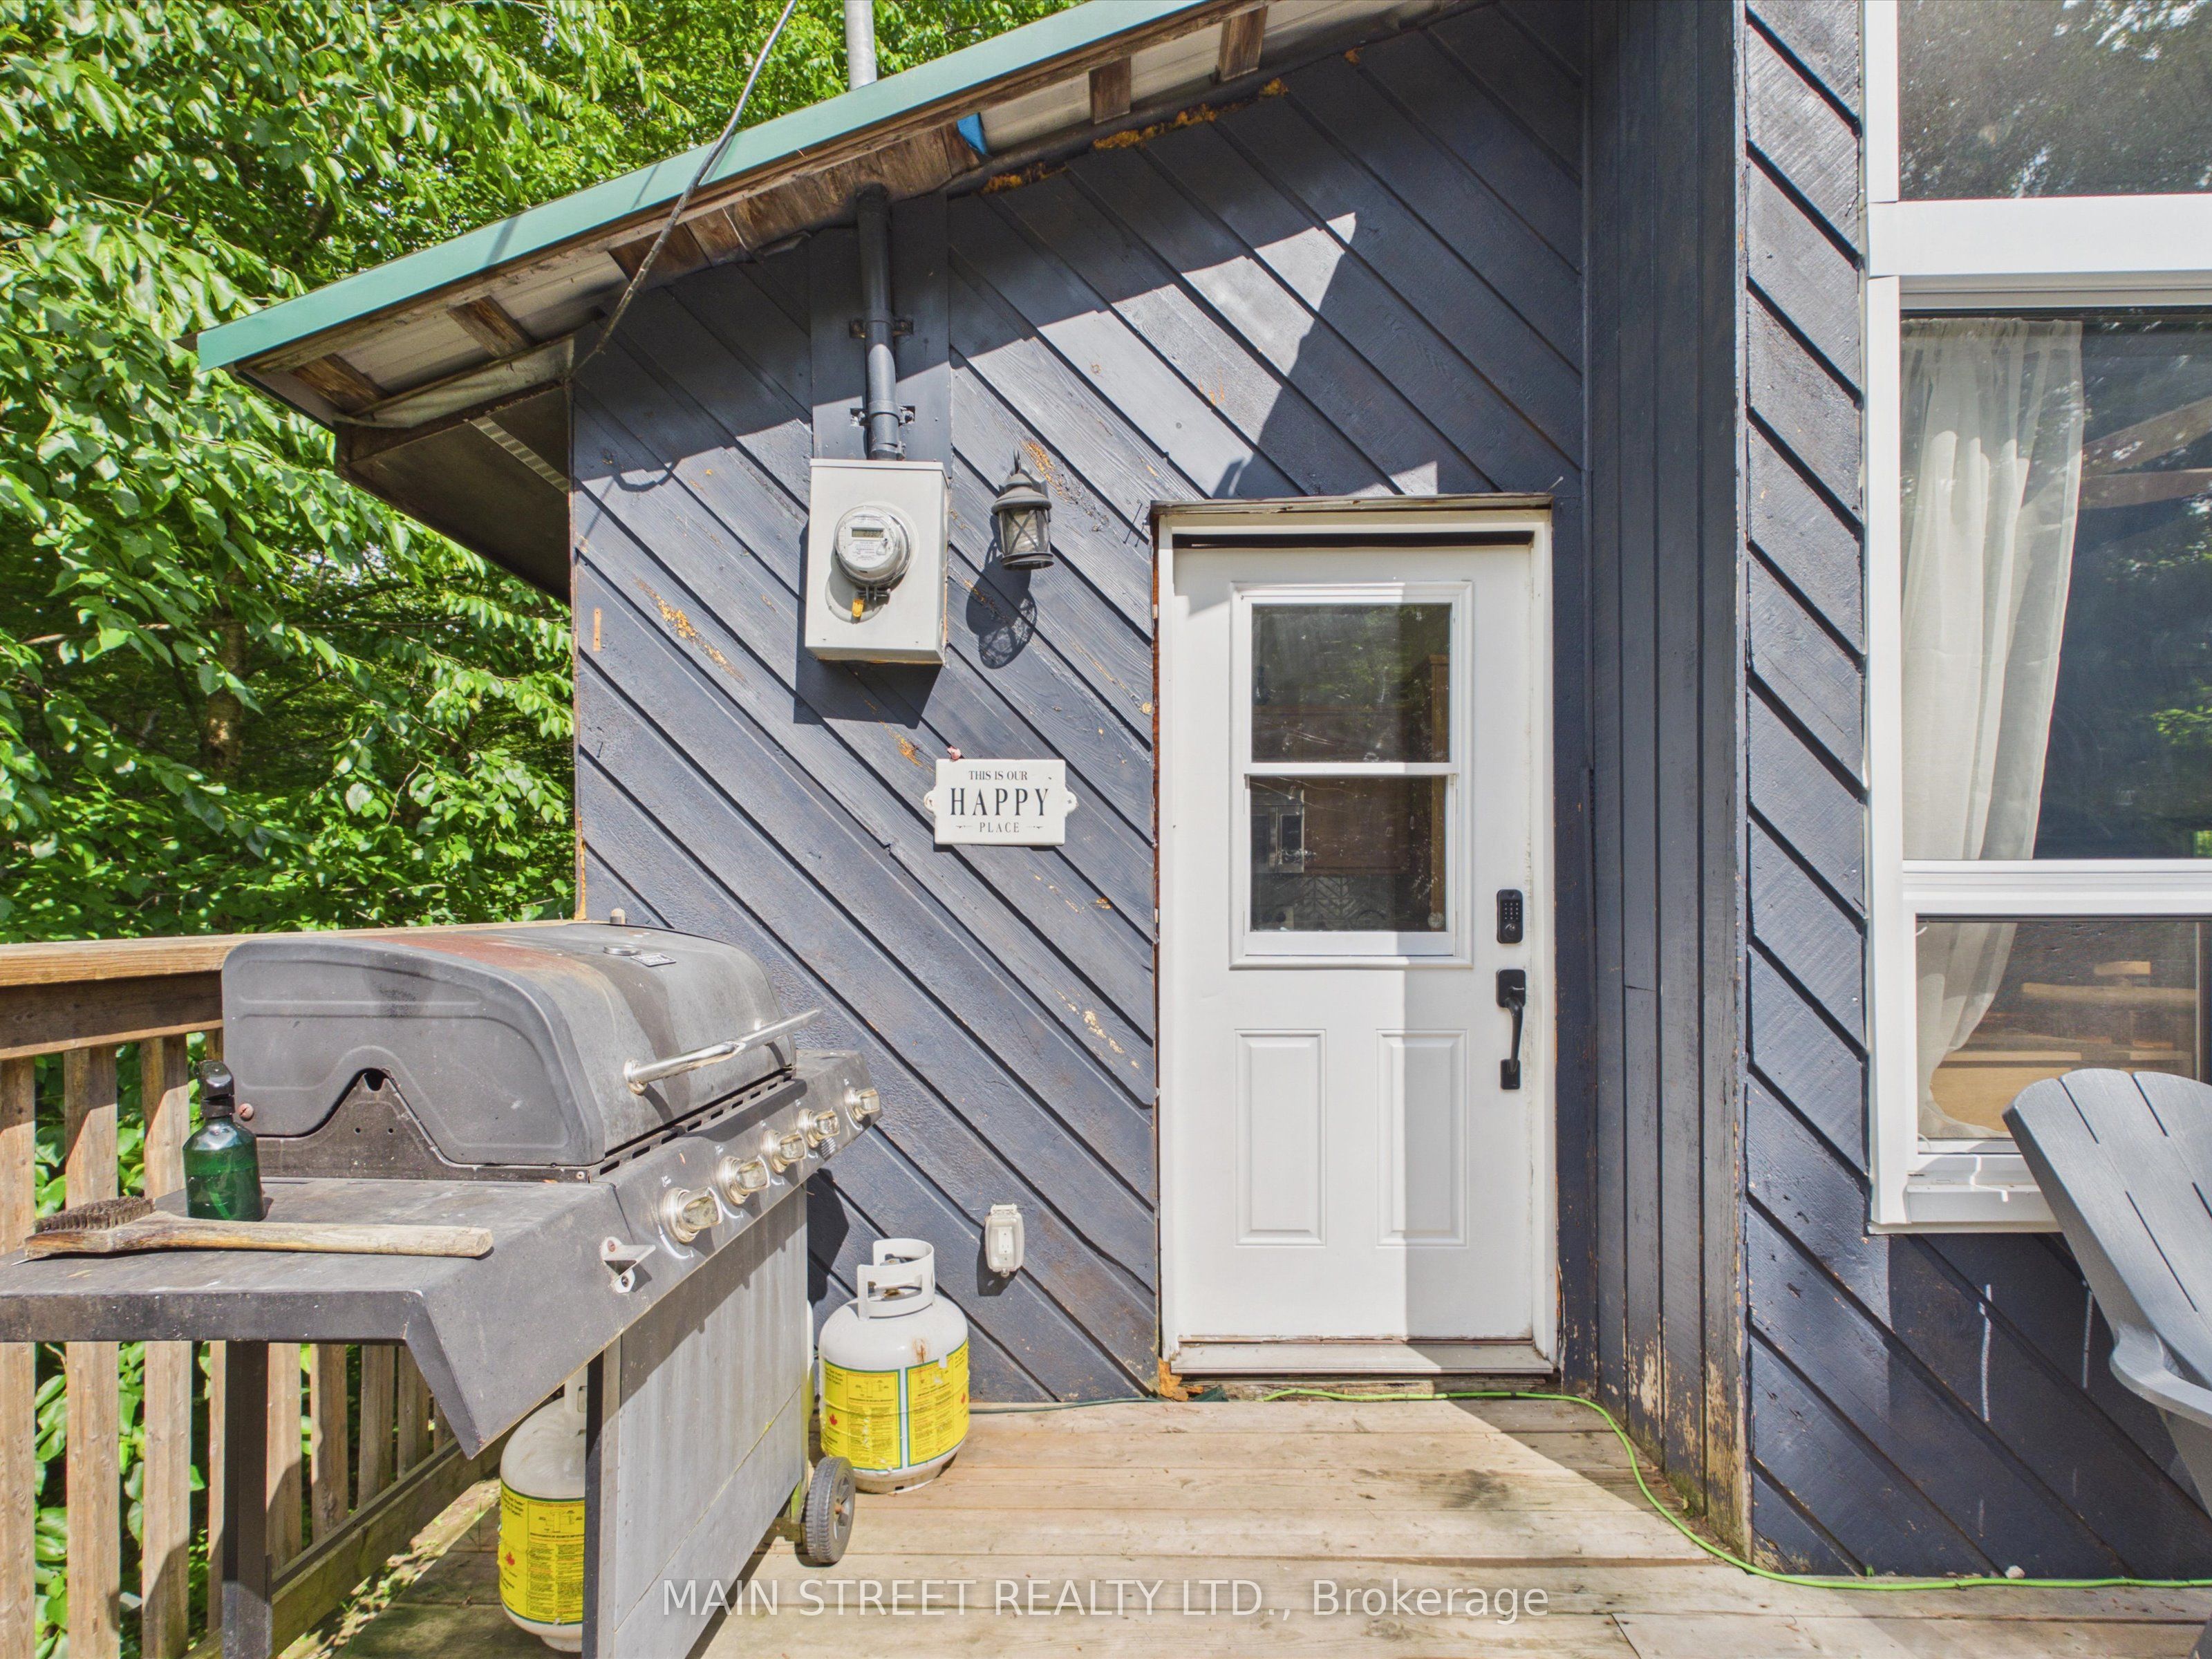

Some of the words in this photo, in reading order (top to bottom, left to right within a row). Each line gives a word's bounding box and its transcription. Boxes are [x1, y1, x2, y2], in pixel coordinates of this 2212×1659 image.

[968, 771, 991, 780] THIS
[995, 771, 1004, 780] IS
[1006, 771, 1028, 780] OUR
[950, 788, 1049, 816] HAPPY
[980, 822, 1020, 833] PLACE
